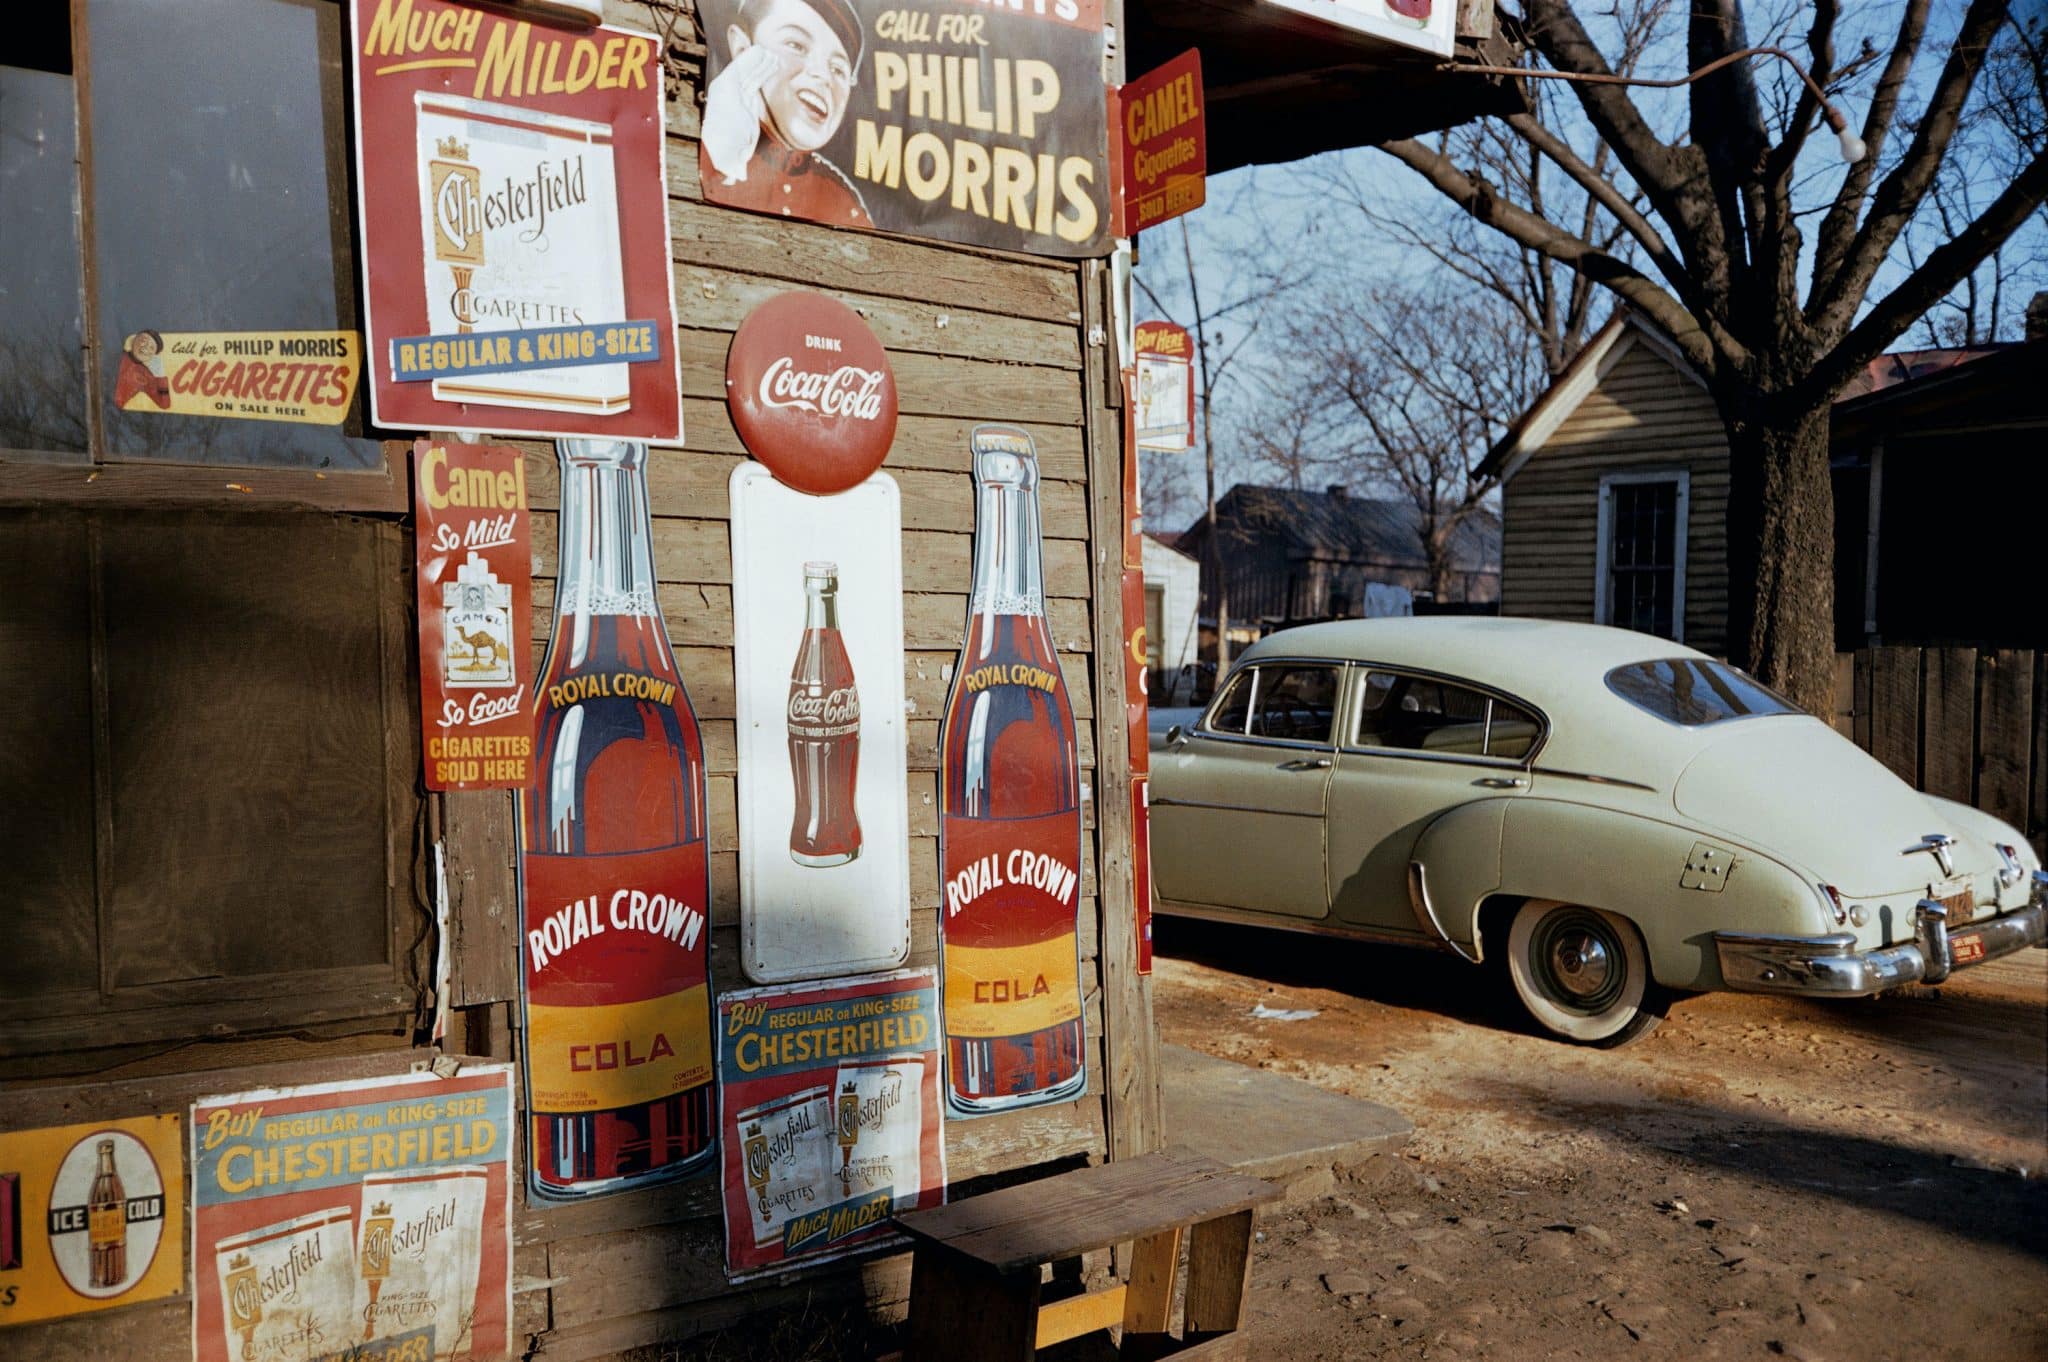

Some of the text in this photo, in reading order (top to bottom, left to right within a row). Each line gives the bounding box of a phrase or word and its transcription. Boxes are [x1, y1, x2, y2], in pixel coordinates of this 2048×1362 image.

[876, 10, 935, 42] CALL
[937, 14, 990, 46] FOR
[364, 0, 650, 99] MUCH MILDER
[874, 51, 1061, 139] PHILIP
[1127, 72, 1199, 146] CAMEL
[854, 119, 1099, 243] MORRIS
[1134, 137, 1196, 185] Cigarettes
[436, 155, 587, 252] Chesterfield
[1139, 186, 1192, 222] SOLD HERE
[451, 288, 584, 330] CIGARETTES
[172, 338, 348, 358] Call for PHILIP MORRIS
[400, 327, 652, 374] REGULAR & KING-SIZE
[805, 335, 841, 352] DRINK
[1135, 328, 1185, 353] BUY HERE
[172, 358, 351, 407] CIGARETTES
[759, 357, 885, 420] Coca-Cola
[215, 402, 306, 417] ON SALE HERE
[421, 447, 527, 511] Camel
[432, 513, 517, 552] So Mild
[452, 613, 502, 626] CAMEL
[549, 672, 676, 709] ROYAL CROWN
[964, 664, 1057, 694] ROYAL CROWN
[437, 684, 524, 728] So Good
[789, 687, 860, 724] Coca-Cola
[429, 735, 530, 759] CIGARETTES
[436, 758, 526, 782] SOLD HERE
[947, 849, 1077, 917] ROYAL CROWN
[529, 888, 704, 972] ROYAL CROWN
[974, 973, 1050, 1003] COLA
[728, 1001, 768, 1036] BUY
[769, 1008, 833, 1030] REGULAR
[853, 995, 920, 1018] KING-SIZE
[569, 1033, 675, 1072] COLA
[735, 1014, 928, 1073] CHESTERFIELD
[204, 1106, 264, 1150] BUY
[264, 1113, 358, 1141] REGULAR
[386, 1096, 487, 1126] KING-SIZE
[750, 1079, 903, 1178] Chesterfield Chesterfield
[215, 1119, 497, 1194] CHESTERFIELD
[839, 1165, 897, 1187] CIGARETTES
[127, 1198, 160, 1220] COLD
[758, 1184, 815, 1214] CIGARETTES
[52, 1209, 85, 1231] ICE
[786, 1195, 889, 1248] MUCH MILDER
[233, 1197, 457, 1320] Chesterfield Chesterfield
[363, 1301, 437, 1326] CIGARETTES
